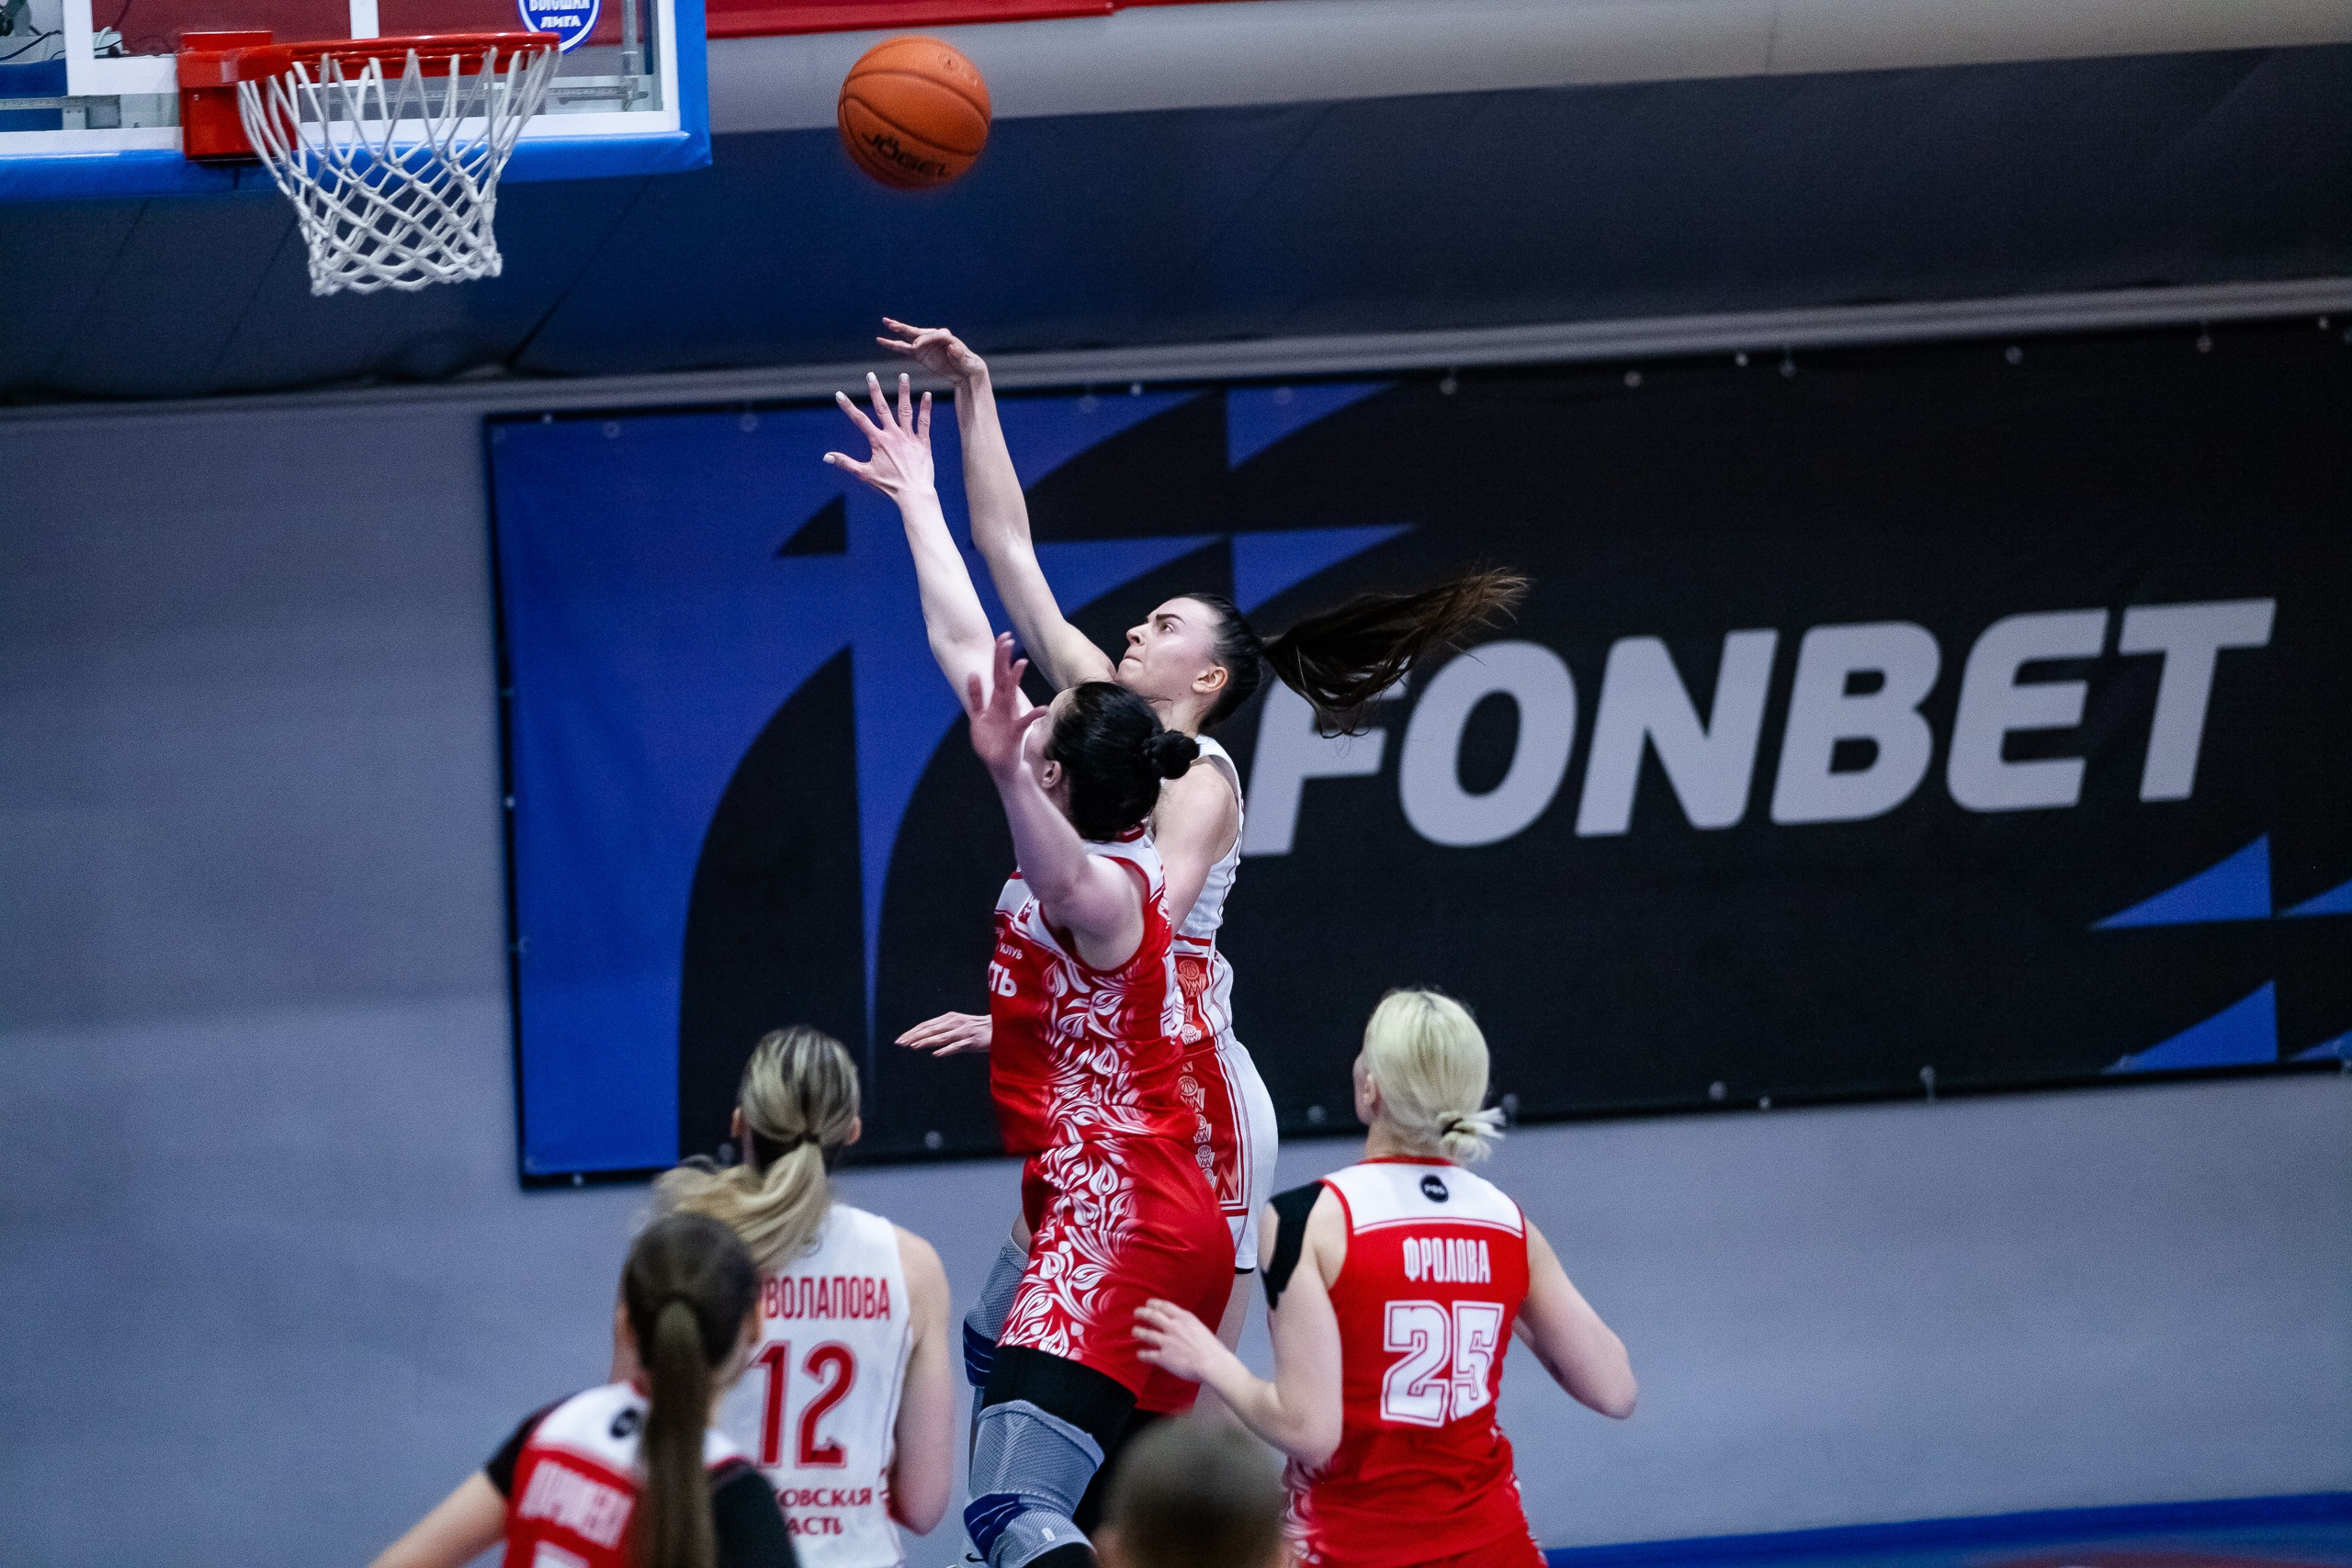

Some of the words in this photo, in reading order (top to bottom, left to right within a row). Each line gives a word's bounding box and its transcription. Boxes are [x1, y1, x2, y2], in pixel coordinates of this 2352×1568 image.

[540, 16, 582, 28] ЛИГА
[1238, 598, 2278, 857] FONBET
[989, 960, 1017, 998] ТЬ
[1403, 1237, 1491, 1282] ФРОЛОВА
[764, 1274, 891, 1320] ВОЛАПОВА
[1380, 1300, 1505, 1427] 25
[751, 1339, 858, 1469] 12
[776, 1487, 872, 1507] ОВСКАЯ
